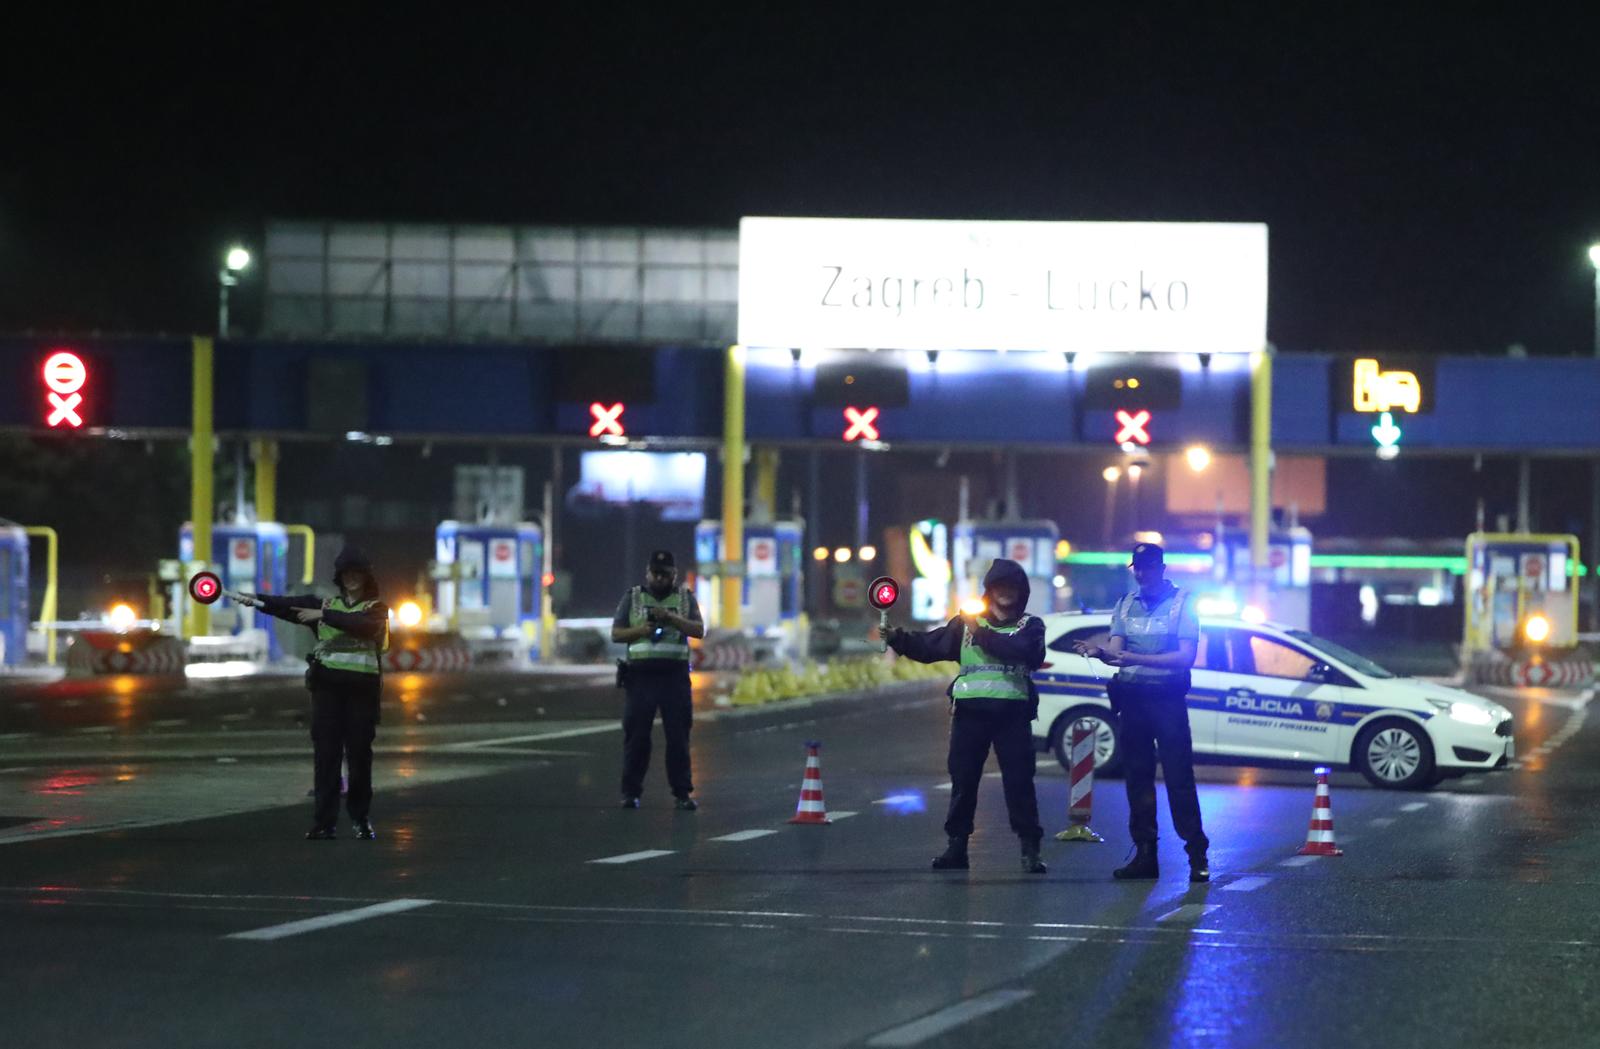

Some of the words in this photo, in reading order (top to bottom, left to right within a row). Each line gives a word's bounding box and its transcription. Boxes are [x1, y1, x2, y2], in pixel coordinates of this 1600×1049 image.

[821, 265, 984, 318] Zagreb
[1047, 269, 1189, 311] Lucko
[1225, 695, 1303, 716] POLICIJA
